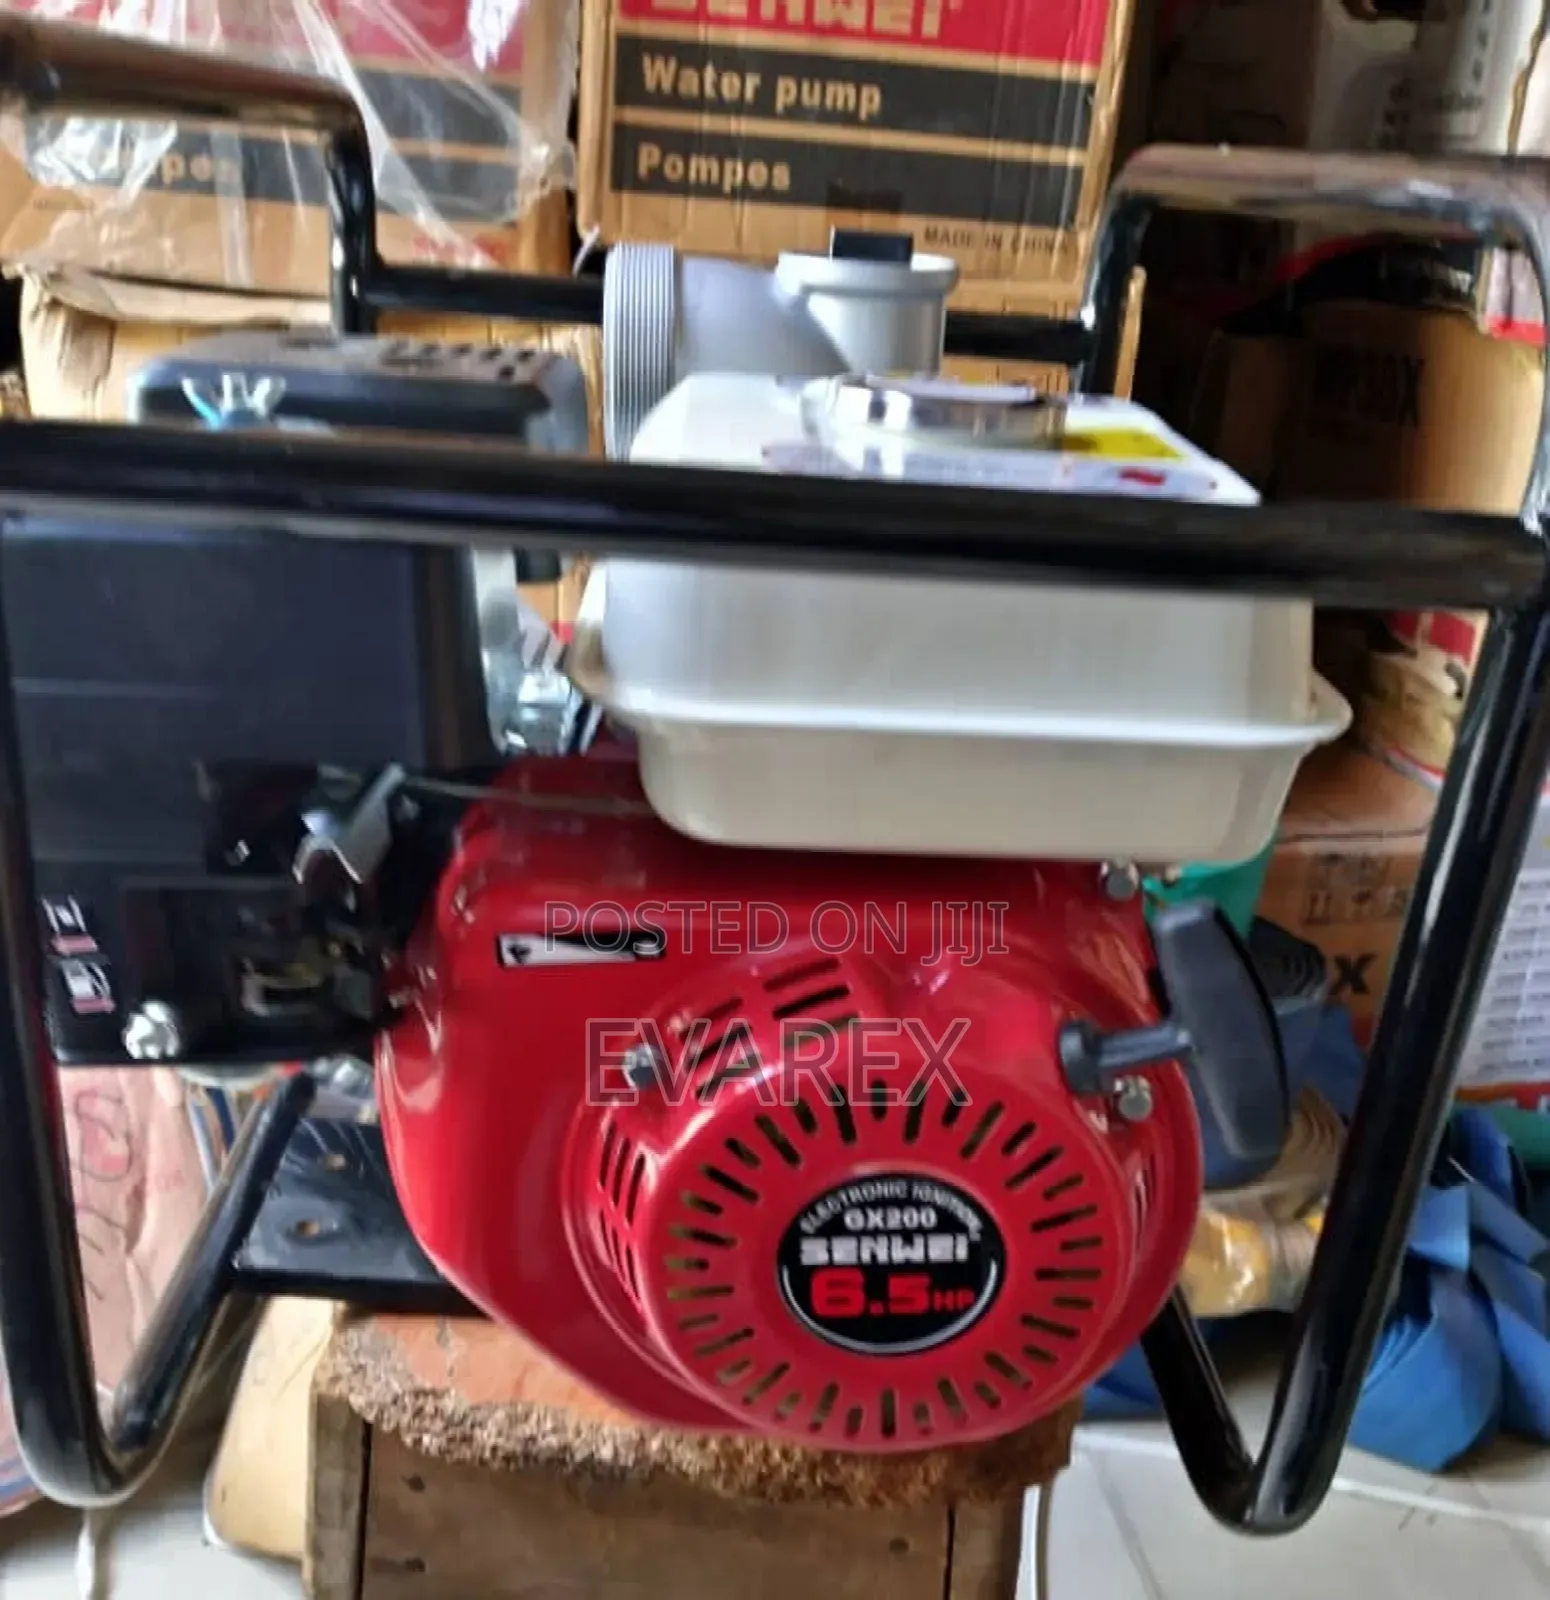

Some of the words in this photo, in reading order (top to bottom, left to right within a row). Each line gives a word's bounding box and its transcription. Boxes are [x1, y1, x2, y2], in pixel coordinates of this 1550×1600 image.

[642, 53, 761, 105] Water
[775, 75, 882, 121] pump
[637, 142, 791, 193] Pompes
[924, 225, 971, 248] MADE
[985, 232, 1003, 249] IN
[800, 1180, 908, 1235] ELECTRONIC
[843, 1207, 938, 1231] GX200
[800, 1233, 969, 1265] SENWEI
[810, 1267, 931, 1318] 6.5
[933, 1289, 976, 1311] HP
